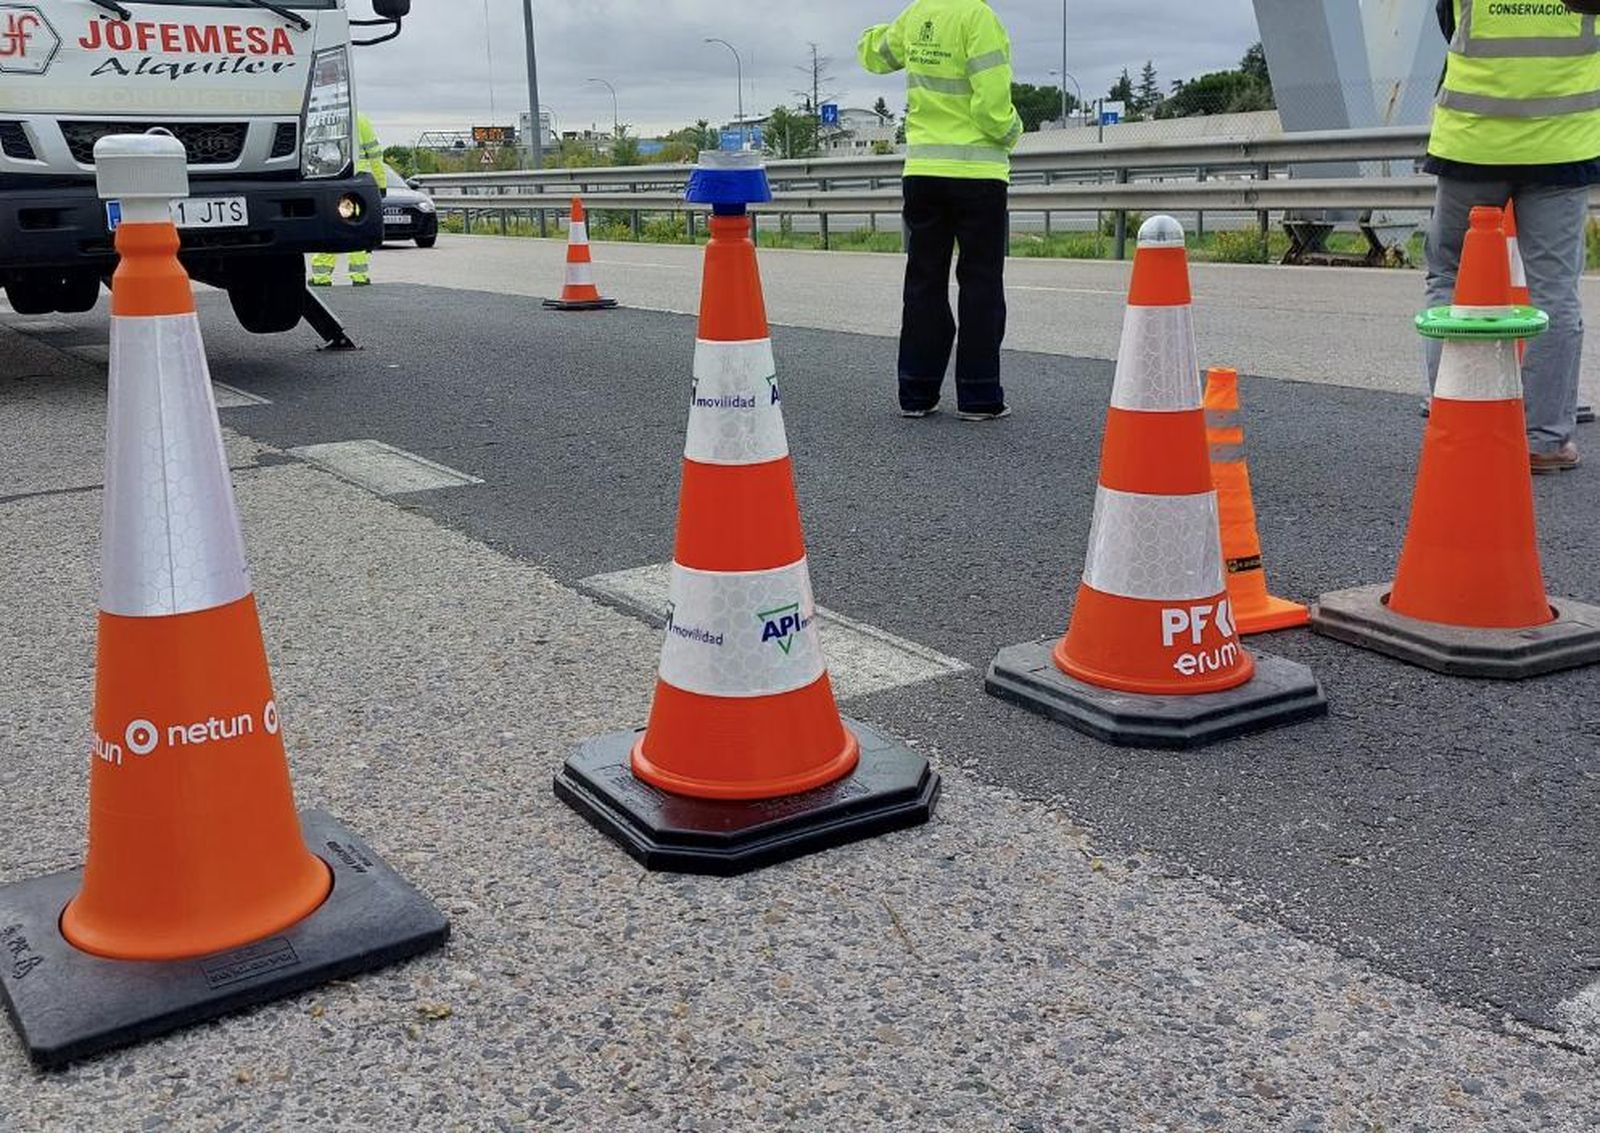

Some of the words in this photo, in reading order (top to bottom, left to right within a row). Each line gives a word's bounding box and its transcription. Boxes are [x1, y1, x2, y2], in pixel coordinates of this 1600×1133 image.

[79, 20, 294, 55] JOFEMESA
[90, 56, 297, 80] Alquiler
[199, 200, 243, 223] JTS
[697, 396, 756, 408] movilidad
[673, 624, 724, 646] movilidad
[761, 613, 801, 642] API
[168, 713, 252, 747] netun
